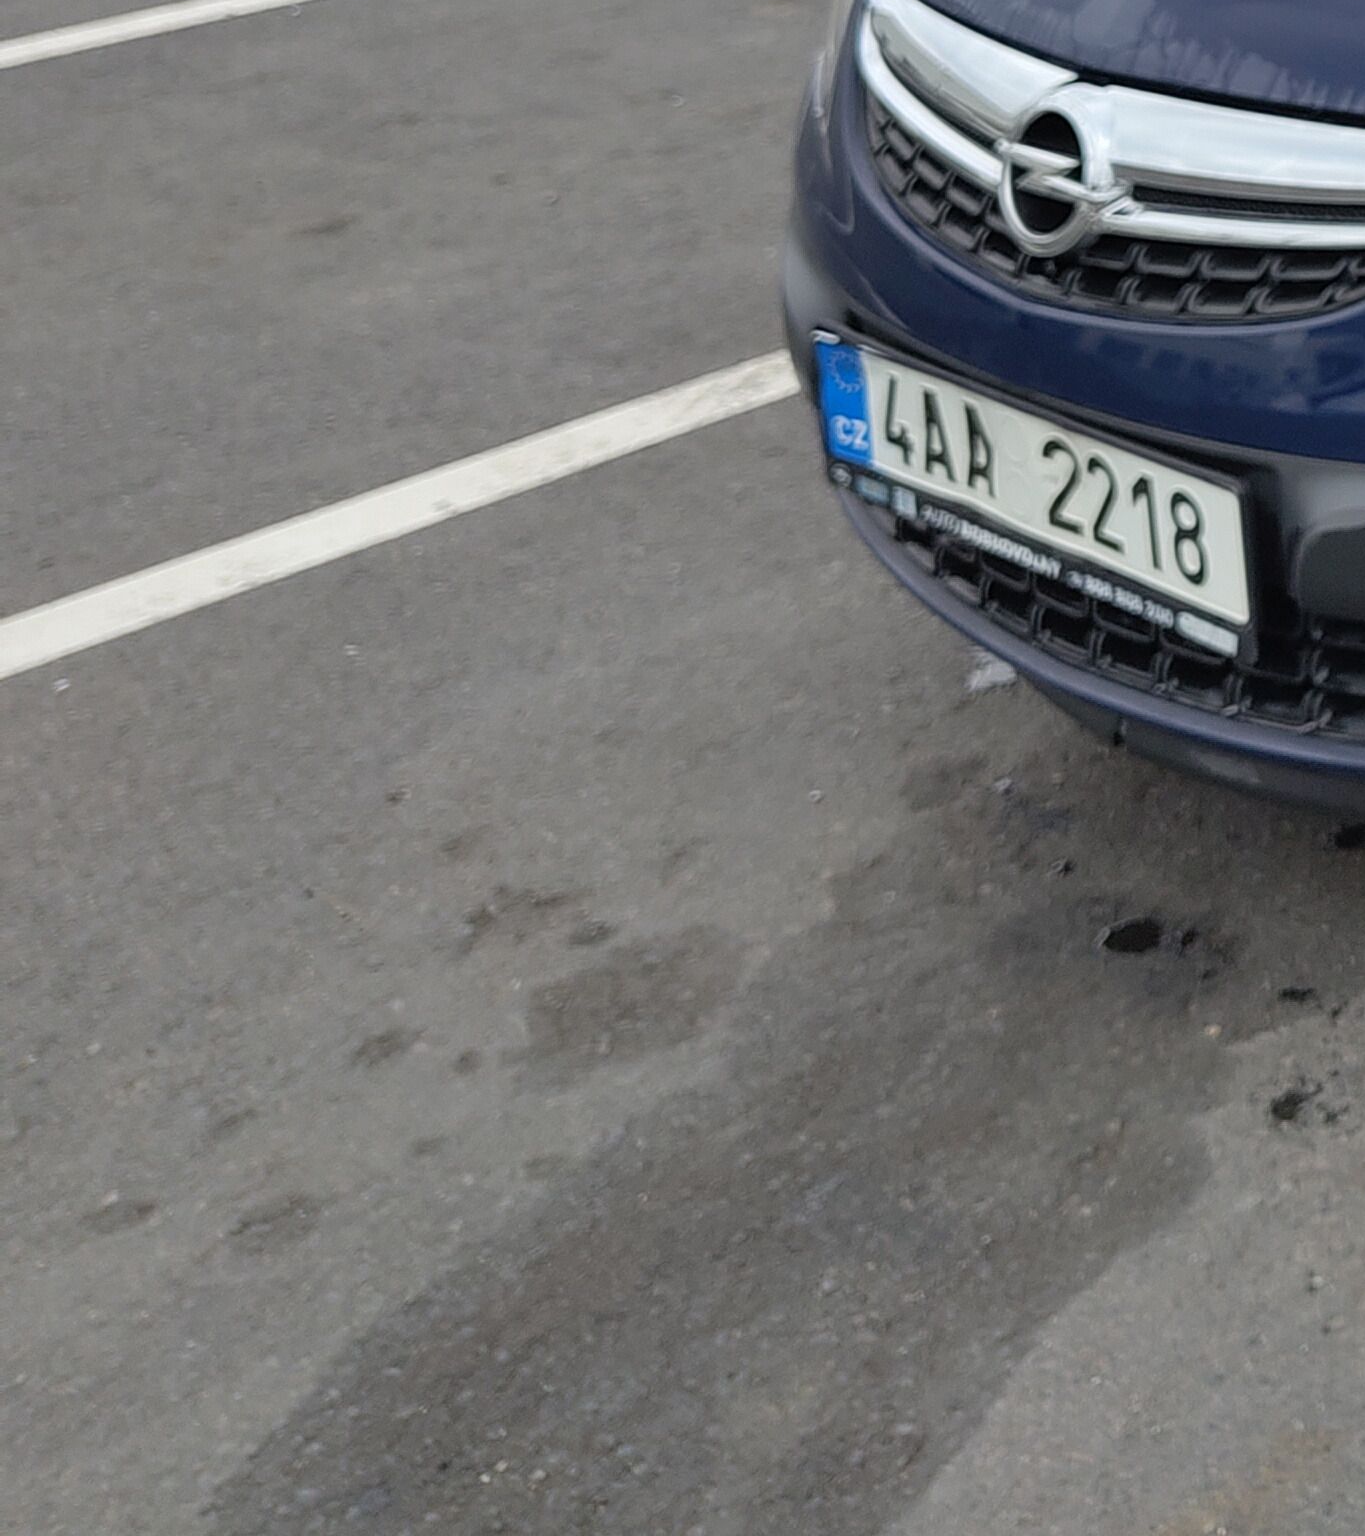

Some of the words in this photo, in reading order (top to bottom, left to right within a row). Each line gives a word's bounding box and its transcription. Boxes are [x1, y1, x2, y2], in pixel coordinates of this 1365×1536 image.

[833, 417, 870, 452] CZ
[883, 371, 997, 499] 4AA
[1041, 437, 1211, 586] 2218
